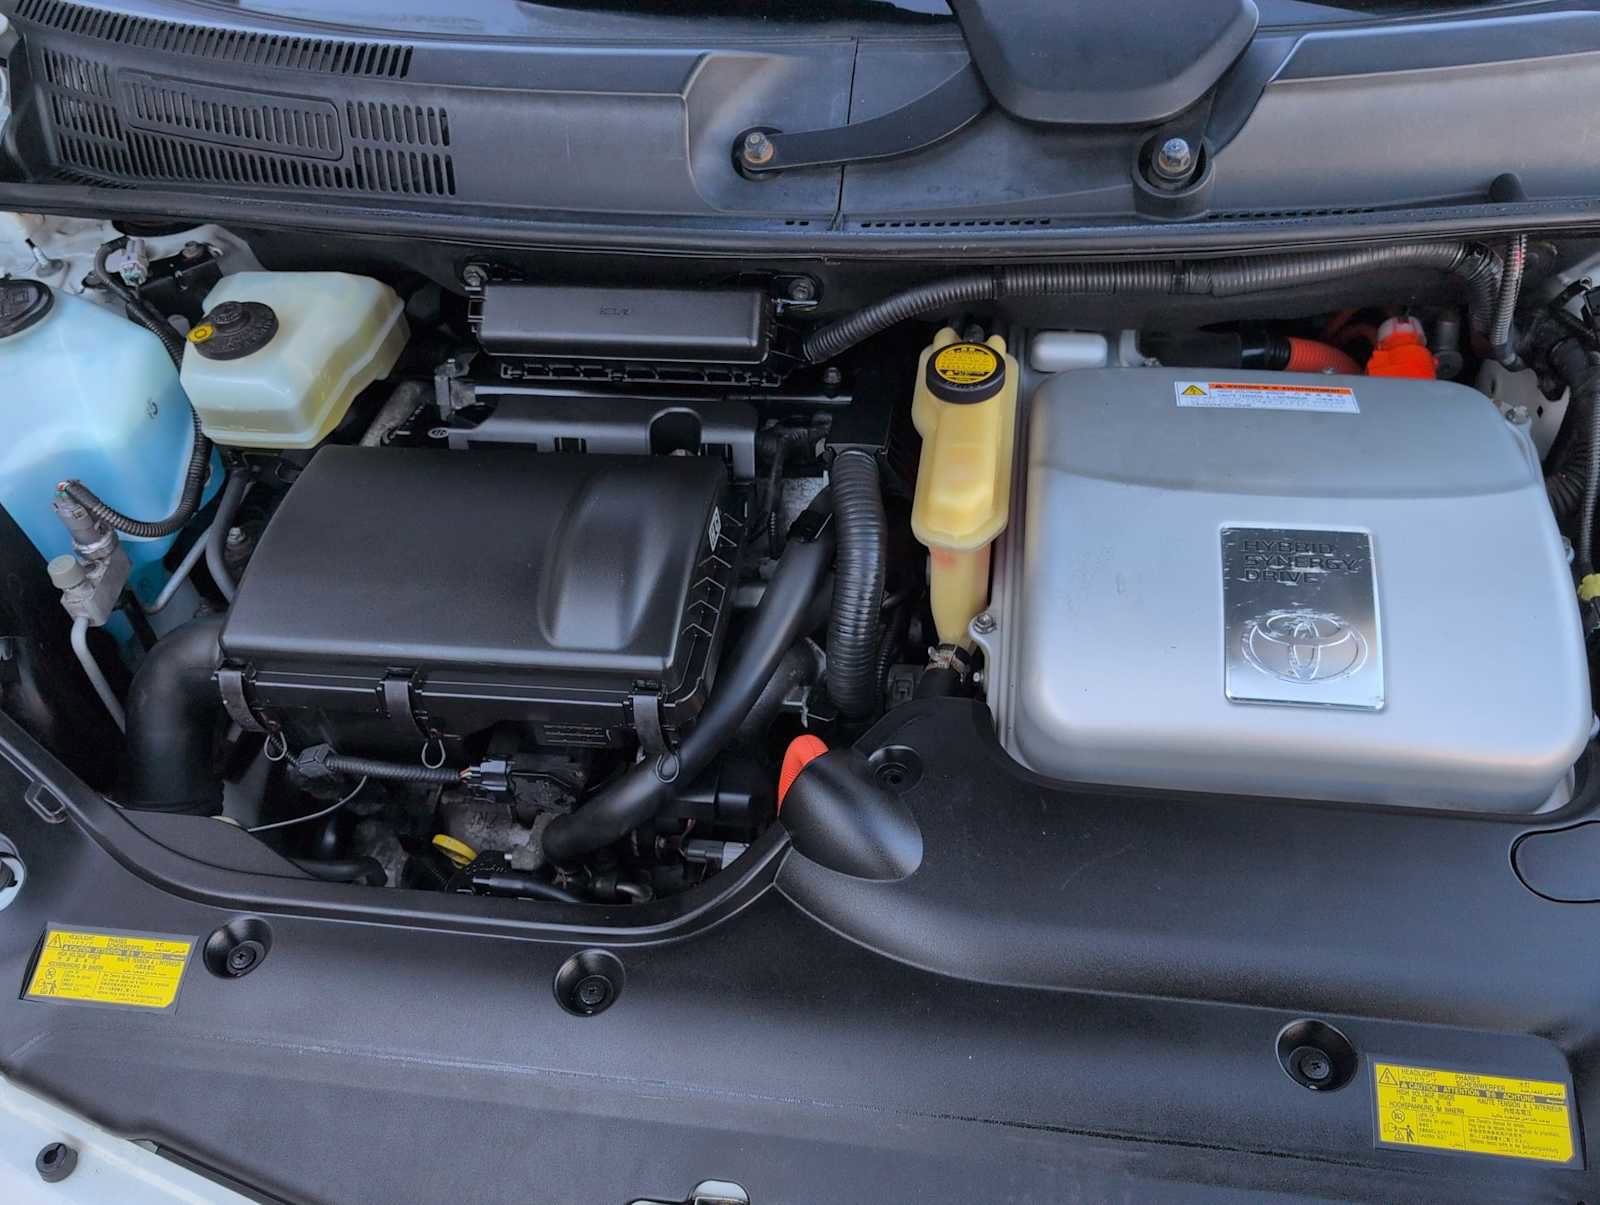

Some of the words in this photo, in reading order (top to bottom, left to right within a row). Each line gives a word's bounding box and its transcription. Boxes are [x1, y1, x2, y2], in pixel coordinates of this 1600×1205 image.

[1241, 540, 1334, 553] HYBRID
[1242, 553, 1357, 570] SYNERGY
[1243, 567, 1321, 584] DRIVE
[1409, 1082, 1438, 1093] CAUTION
[1443, 1086, 1479, 1097] ATTENTION
